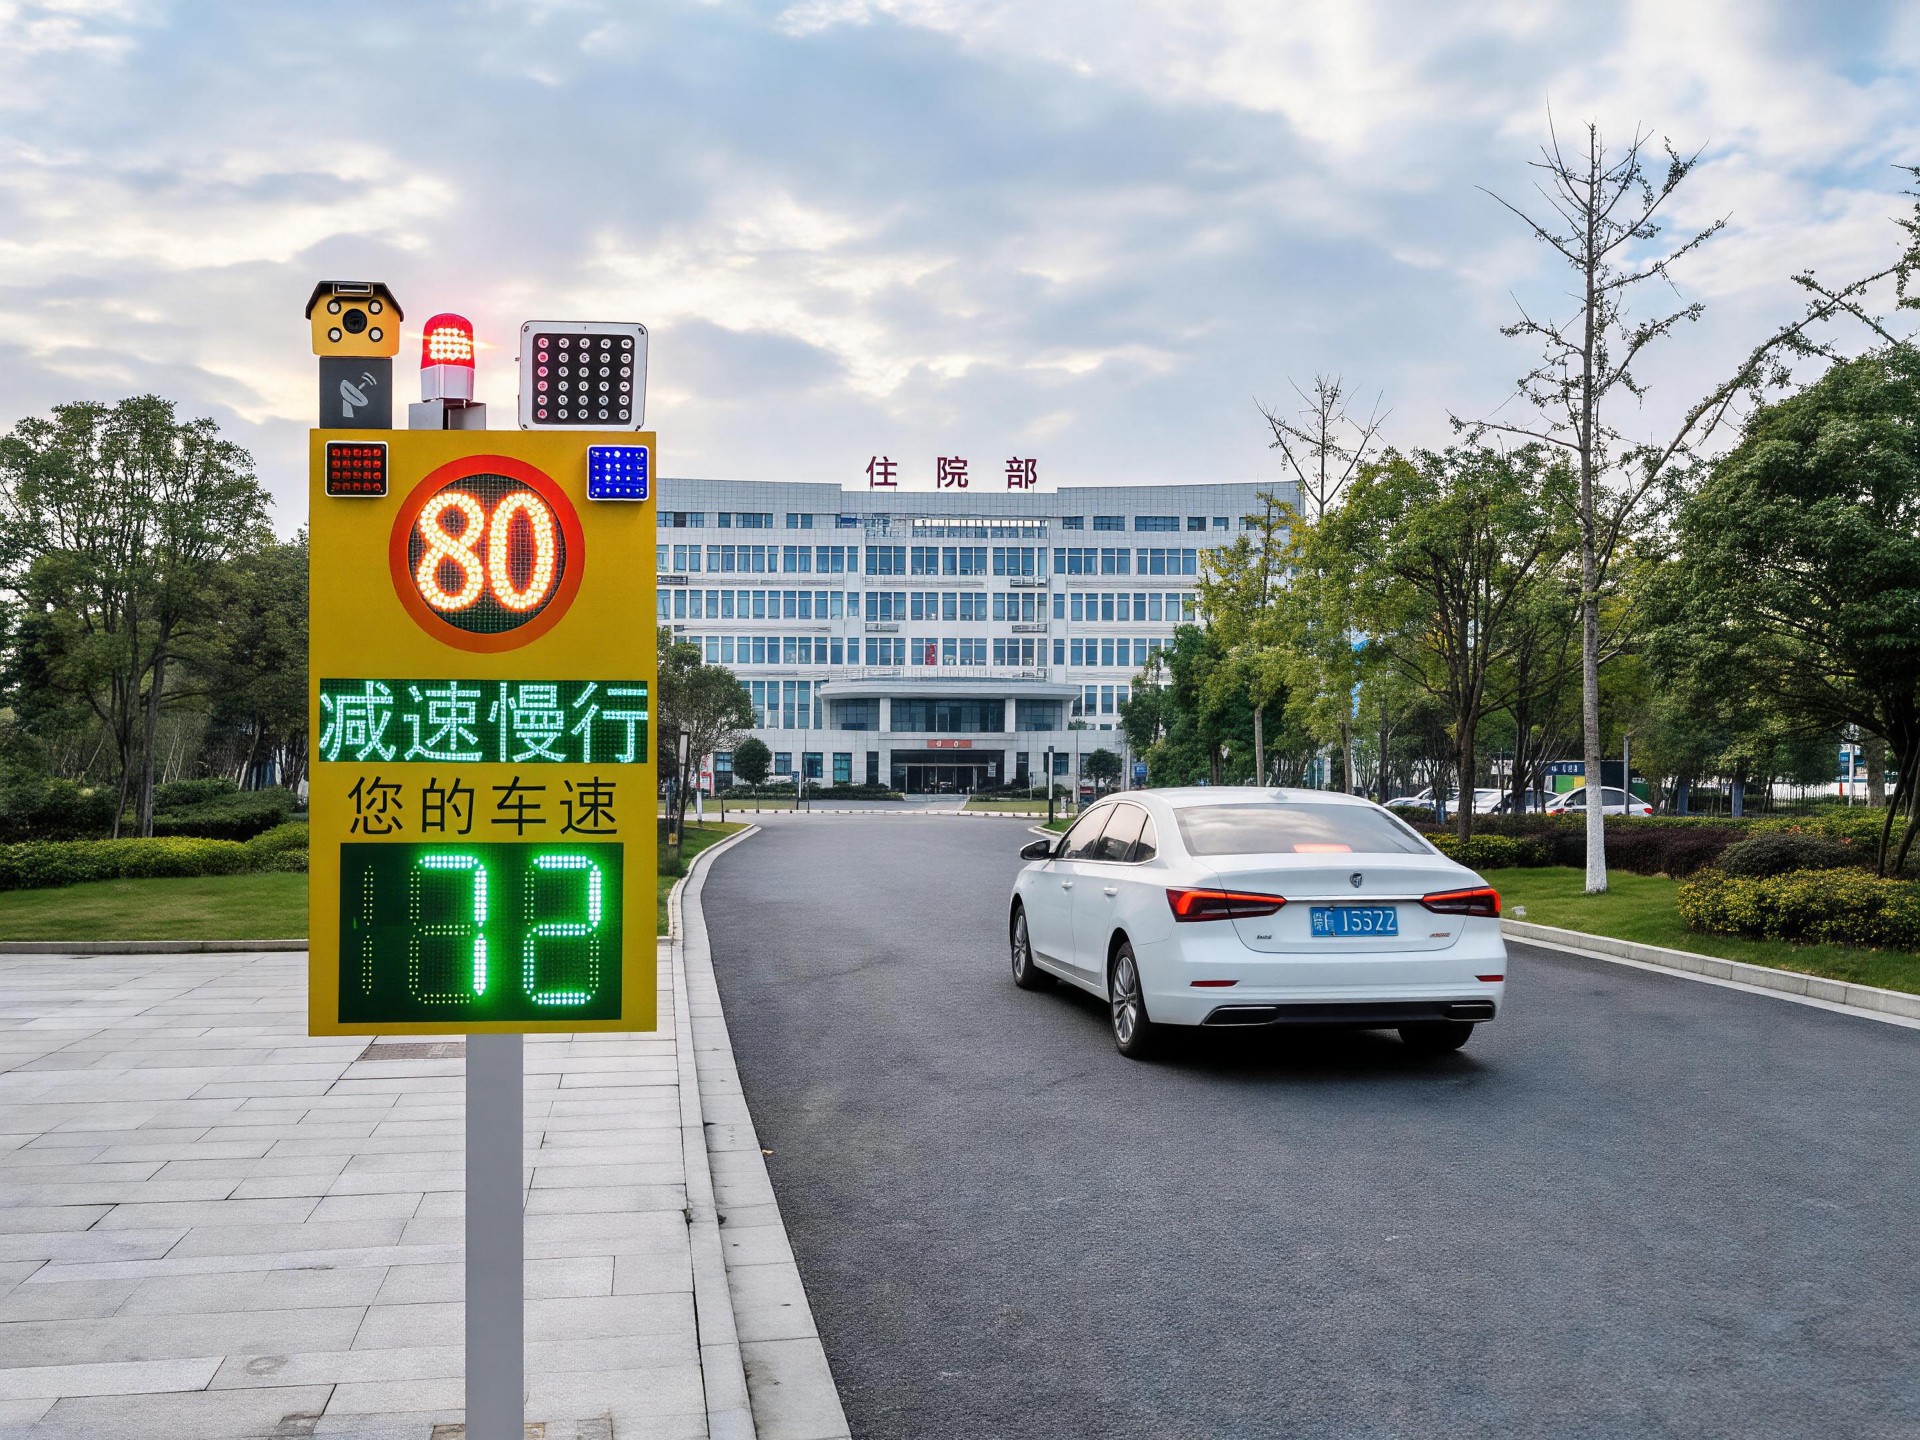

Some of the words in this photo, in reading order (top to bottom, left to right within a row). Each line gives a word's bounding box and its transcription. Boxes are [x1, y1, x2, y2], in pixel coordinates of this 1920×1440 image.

[866, 456, 1038, 489] 住院部
[416, 490, 556, 612] 80
[319, 681, 648, 763] 减速慢行
[347, 775, 618, 836] 您的车速
[418, 854, 602, 1005] 72
